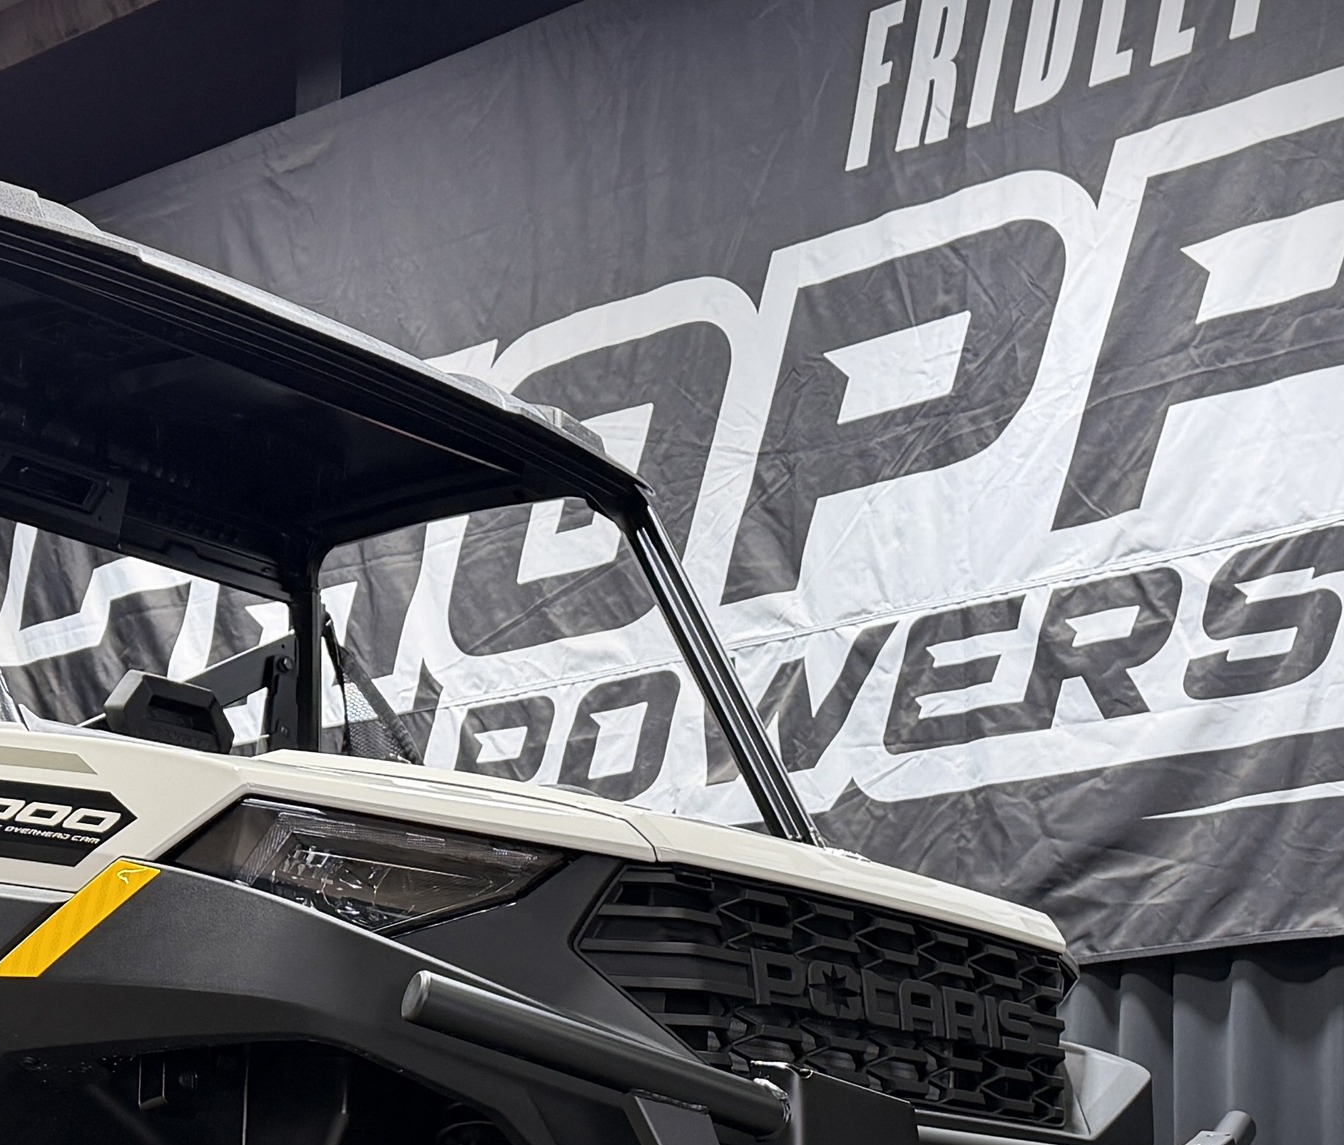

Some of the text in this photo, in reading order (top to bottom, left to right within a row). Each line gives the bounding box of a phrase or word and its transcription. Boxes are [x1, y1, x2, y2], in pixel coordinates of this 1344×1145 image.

[845, 0, 1258, 171] FRIDL
[4, 825, 71, 841] OVERHEAD
[71, 834, 101, 845] CAM
[751, 947, 1037, 1053] POLARIS
